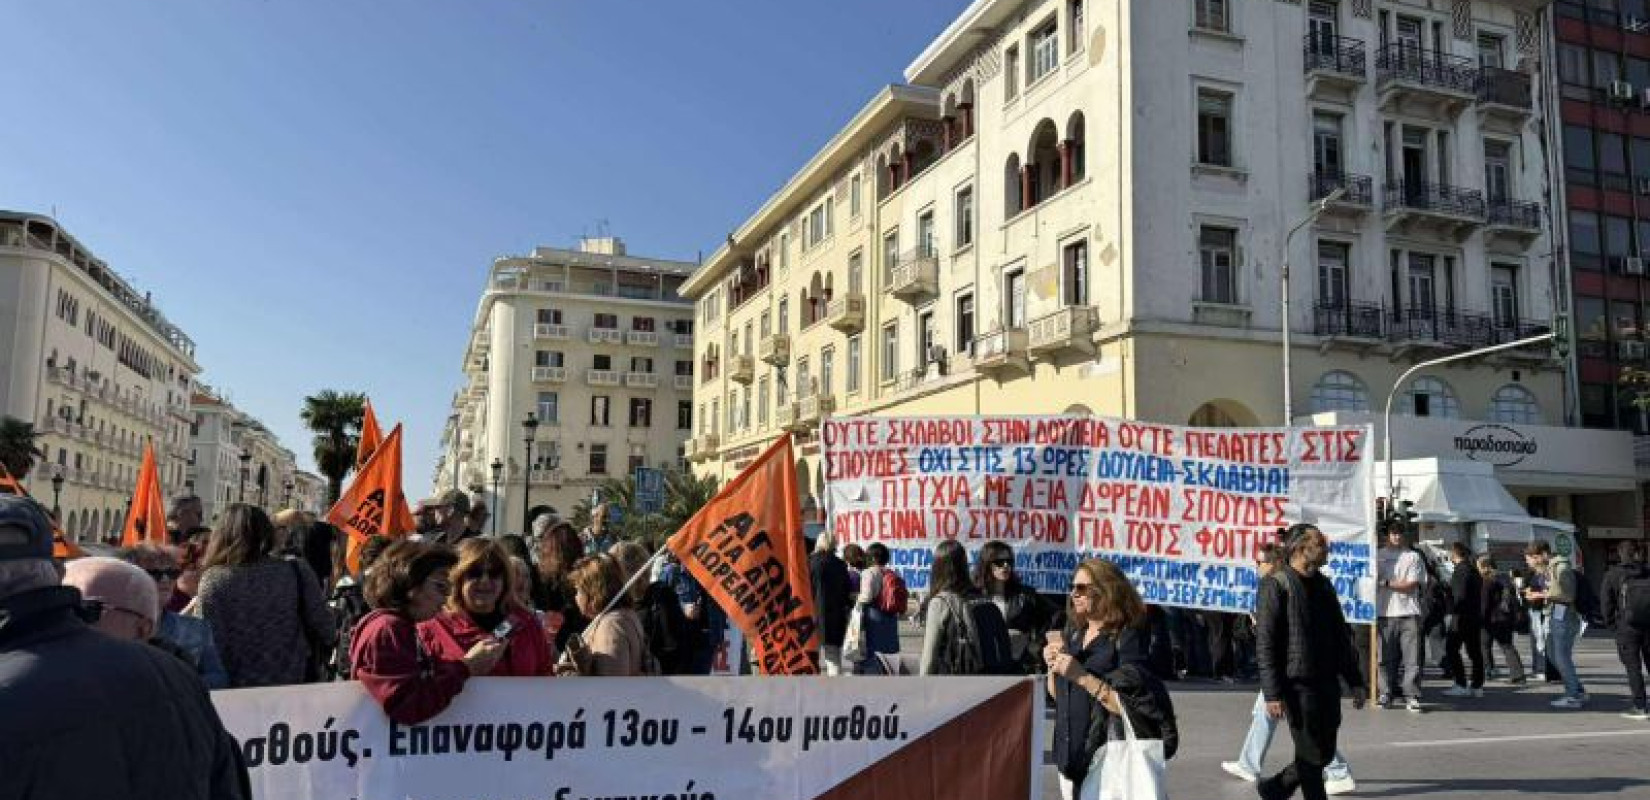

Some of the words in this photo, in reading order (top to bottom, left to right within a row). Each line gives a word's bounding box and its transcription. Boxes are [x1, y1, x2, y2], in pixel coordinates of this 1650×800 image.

[824, 420, 878, 446] ΟΥΤΕ
[887, 420, 973, 444] ΣΚΛΑΒΟΙ
[982, 419, 1030, 444] ΣΤΗΝ
[1036, 419, 1109, 448] ΔΟΥΛΕΙΑ
[1118, 423, 1173, 456] ΟΥΤΕ
[1185, 431, 1288, 464] ΠΕΛΑΤΕΣ
[1302, 431, 1360, 462] ΣΤΙΣ
[826, 448, 910, 480] ΣΠΟΥΔΕΣ
[919, 447, 951, 473] ΟΧΙ
[957, 447, 1005, 473] ΣΤΙΣ
[1013, 447, 1036, 475] 13
[882, 476, 970, 508] ΠΤΥΧΙΑ
[985, 475, 1015, 507] ΜΕ
[1023, 478, 1068, 509] ΑΞΙΑ
[1079, 482, 1170, 519] ΔΩΡΕΑΝ
[1182, 489, 1289, 527] ΣΠΟΥΔΕΣ
[836, 510, 875, 543] ΑΥΤΟ
[932, 509, 960, 539] ΤΟ
[968, 509, 1068, 543] ΣΥΓΧΡΟΝΟ
[1078, 517, 1114, 549] ΓΙΑ
[1124, 520, 1182, 555] ΤΟΥΣ
[389, 708, 586, 761] Επαναφορά
[603, 709, 679, 747] 13ου
[723, 706, 792, 744] 14ου
[802, 703, 908, 751] μισθού.
